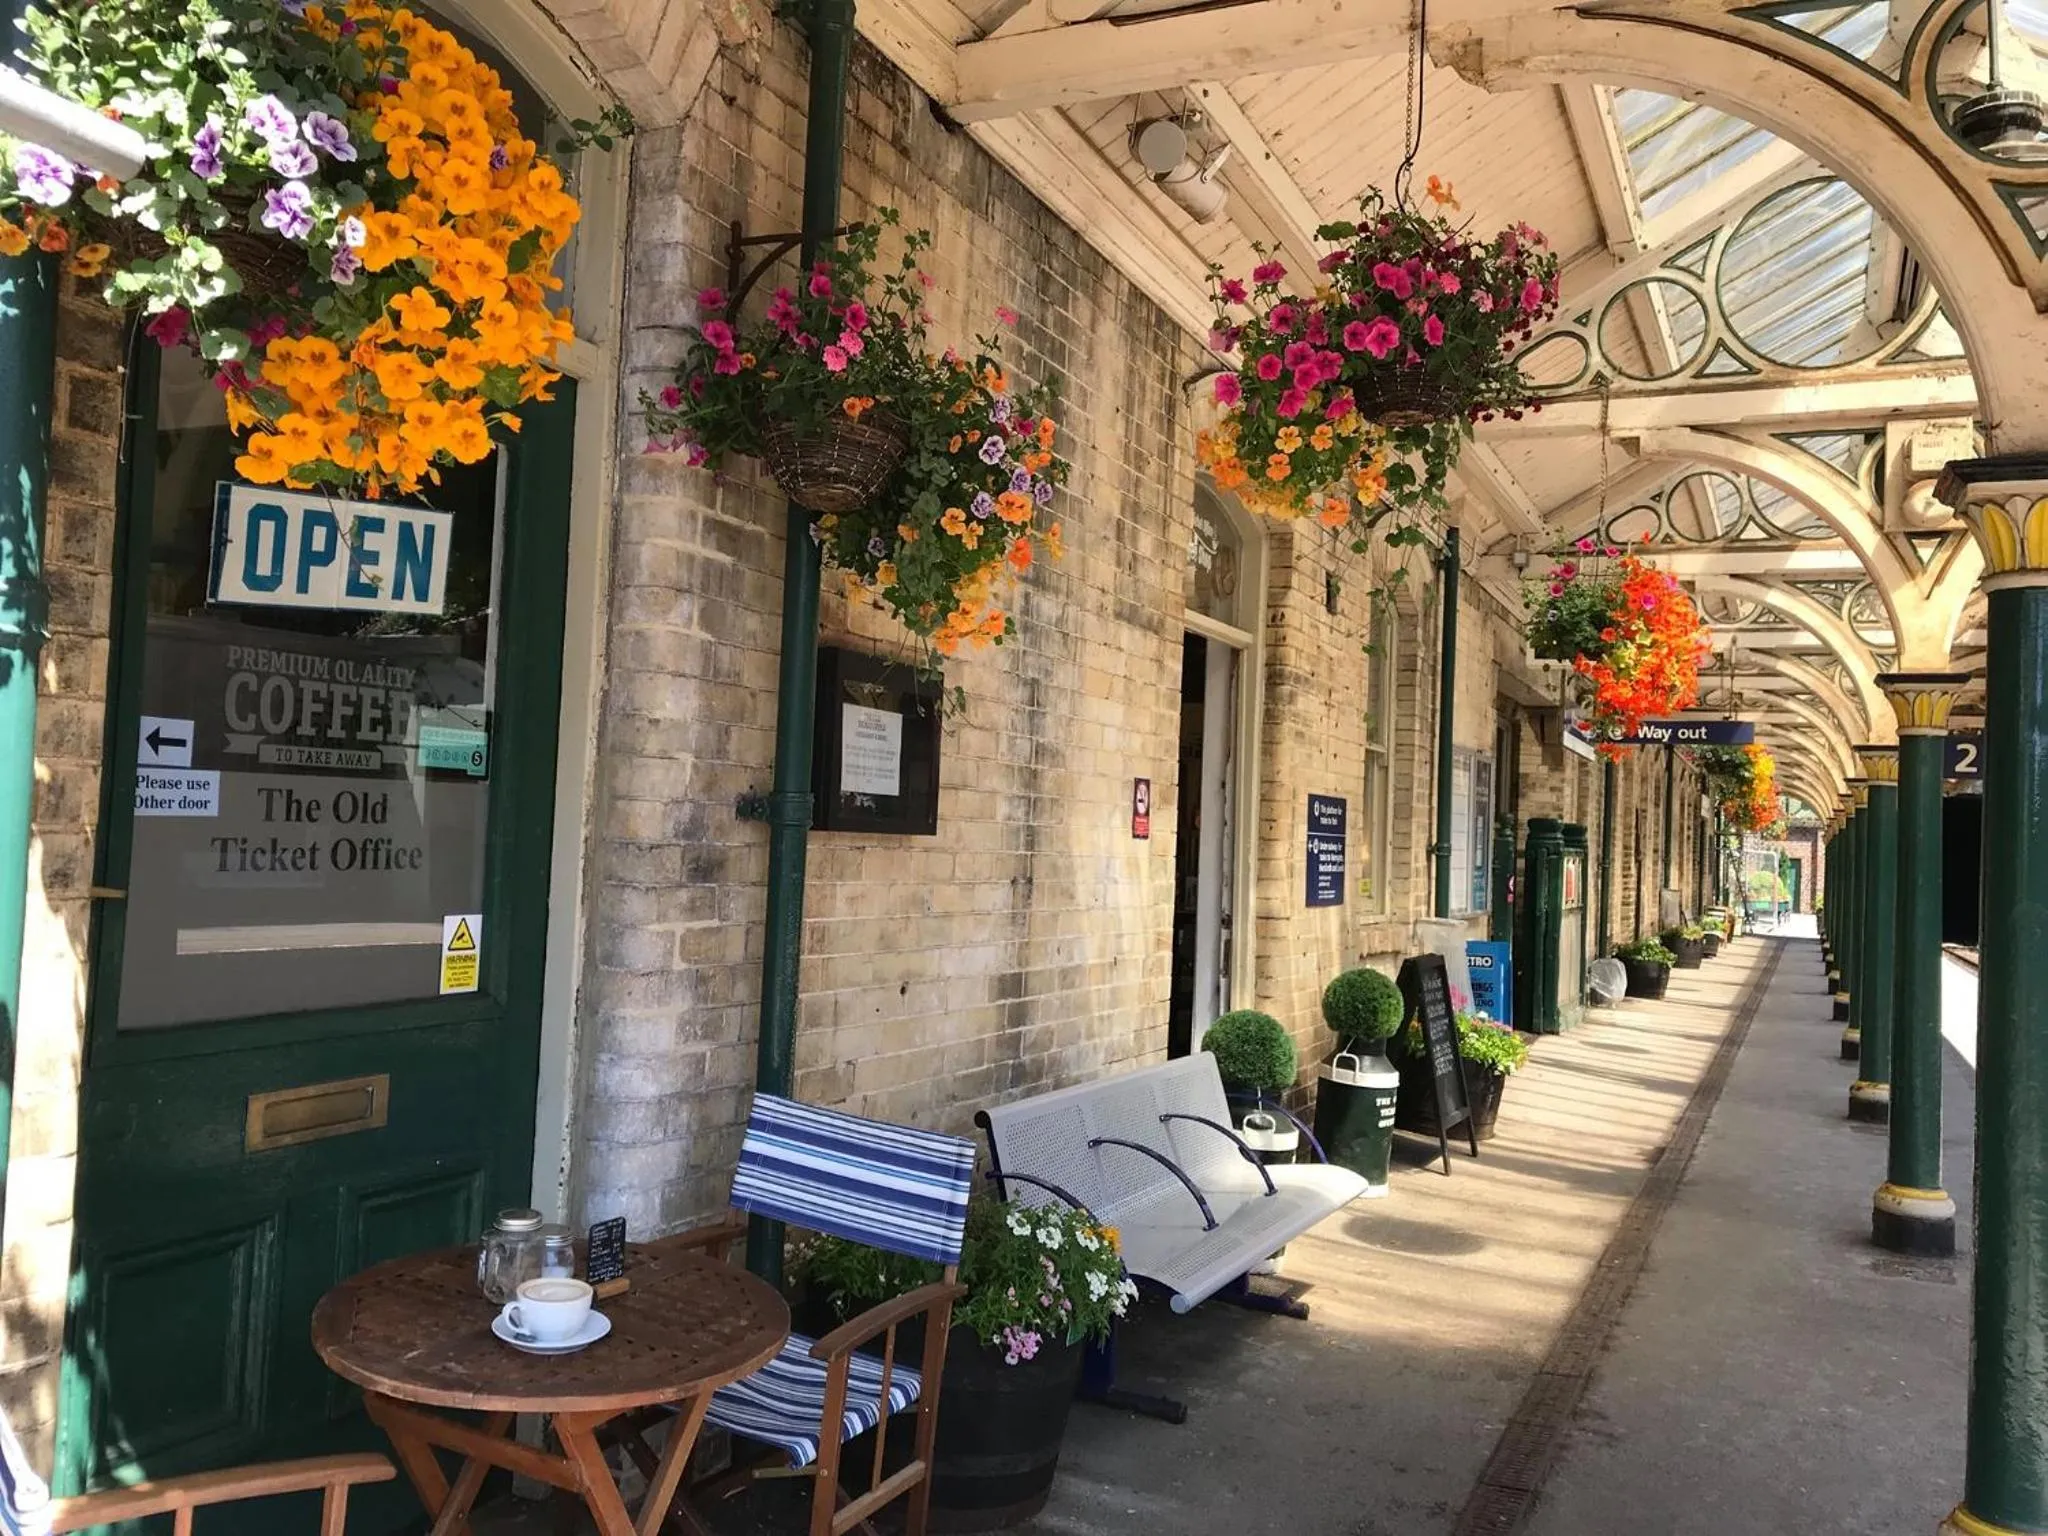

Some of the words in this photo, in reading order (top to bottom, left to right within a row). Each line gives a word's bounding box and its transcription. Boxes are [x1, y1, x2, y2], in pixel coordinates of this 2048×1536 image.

[242, 503, 436, 602] OPEN
[226, 645, 330, 679] PREMIUM
[1638, 725, 1672, 742] Way
[1678, 726, 1707, 739] out
[275, 748, 292, 762] TO
[300, 750, 331, 765] TAKE
[336, 751, 372, 767] AWAY
[1955, 743, 1978, 772] 2
[136, 775, 182, 790] Please
[186, 779, 210, 790] use
[134, 795, 175, 809] Other
[178, 796, 210, 809] door
[257, 787, 321, 823] The
[332, 790, 389, 824] Old
[211, 836, 320, 872] Ticket
[330, 837, 423, 871] Office
[1467, 956, 1492, 968] TRO
